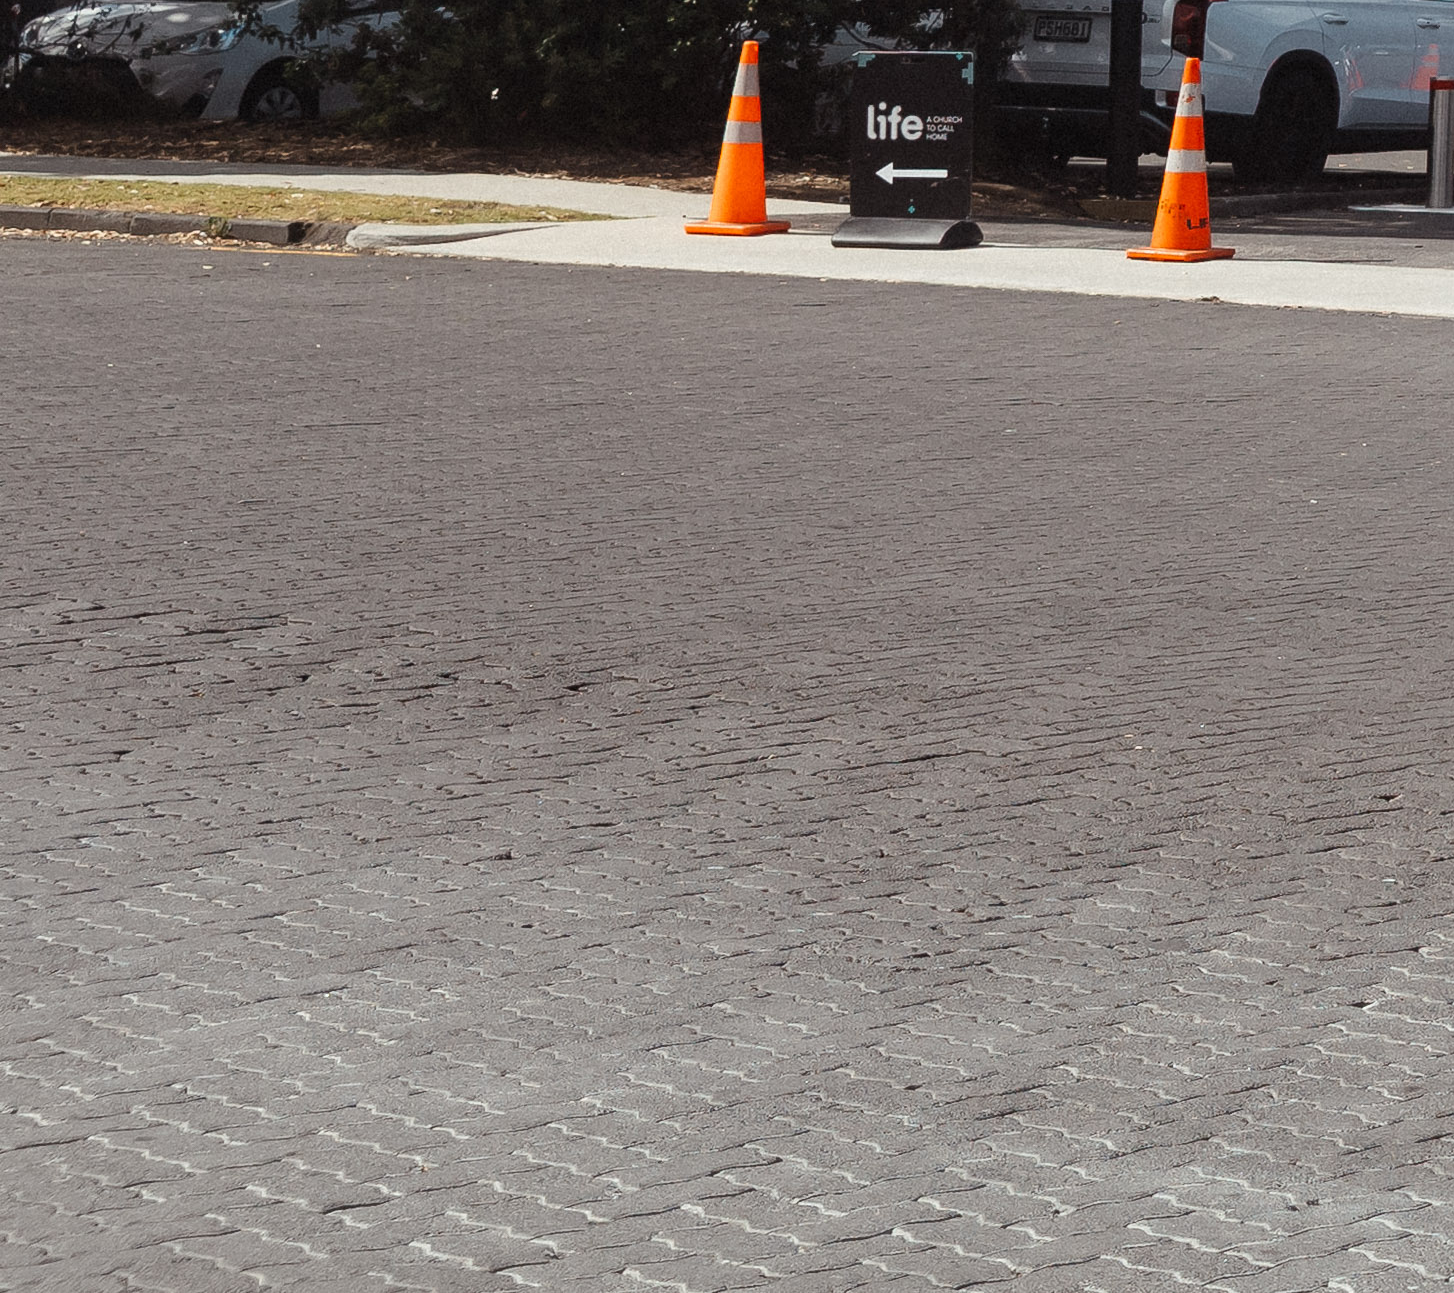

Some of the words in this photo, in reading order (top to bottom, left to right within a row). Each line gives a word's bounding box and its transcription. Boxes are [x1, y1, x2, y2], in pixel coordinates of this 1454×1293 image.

[866, 101, 924, 141] life
[933, 115, 963, 124] CHURCH
[926, 124, 935, 132] TO
[937, 124, 955, 132] CALL
[926, 133, 948, 141] HOME
